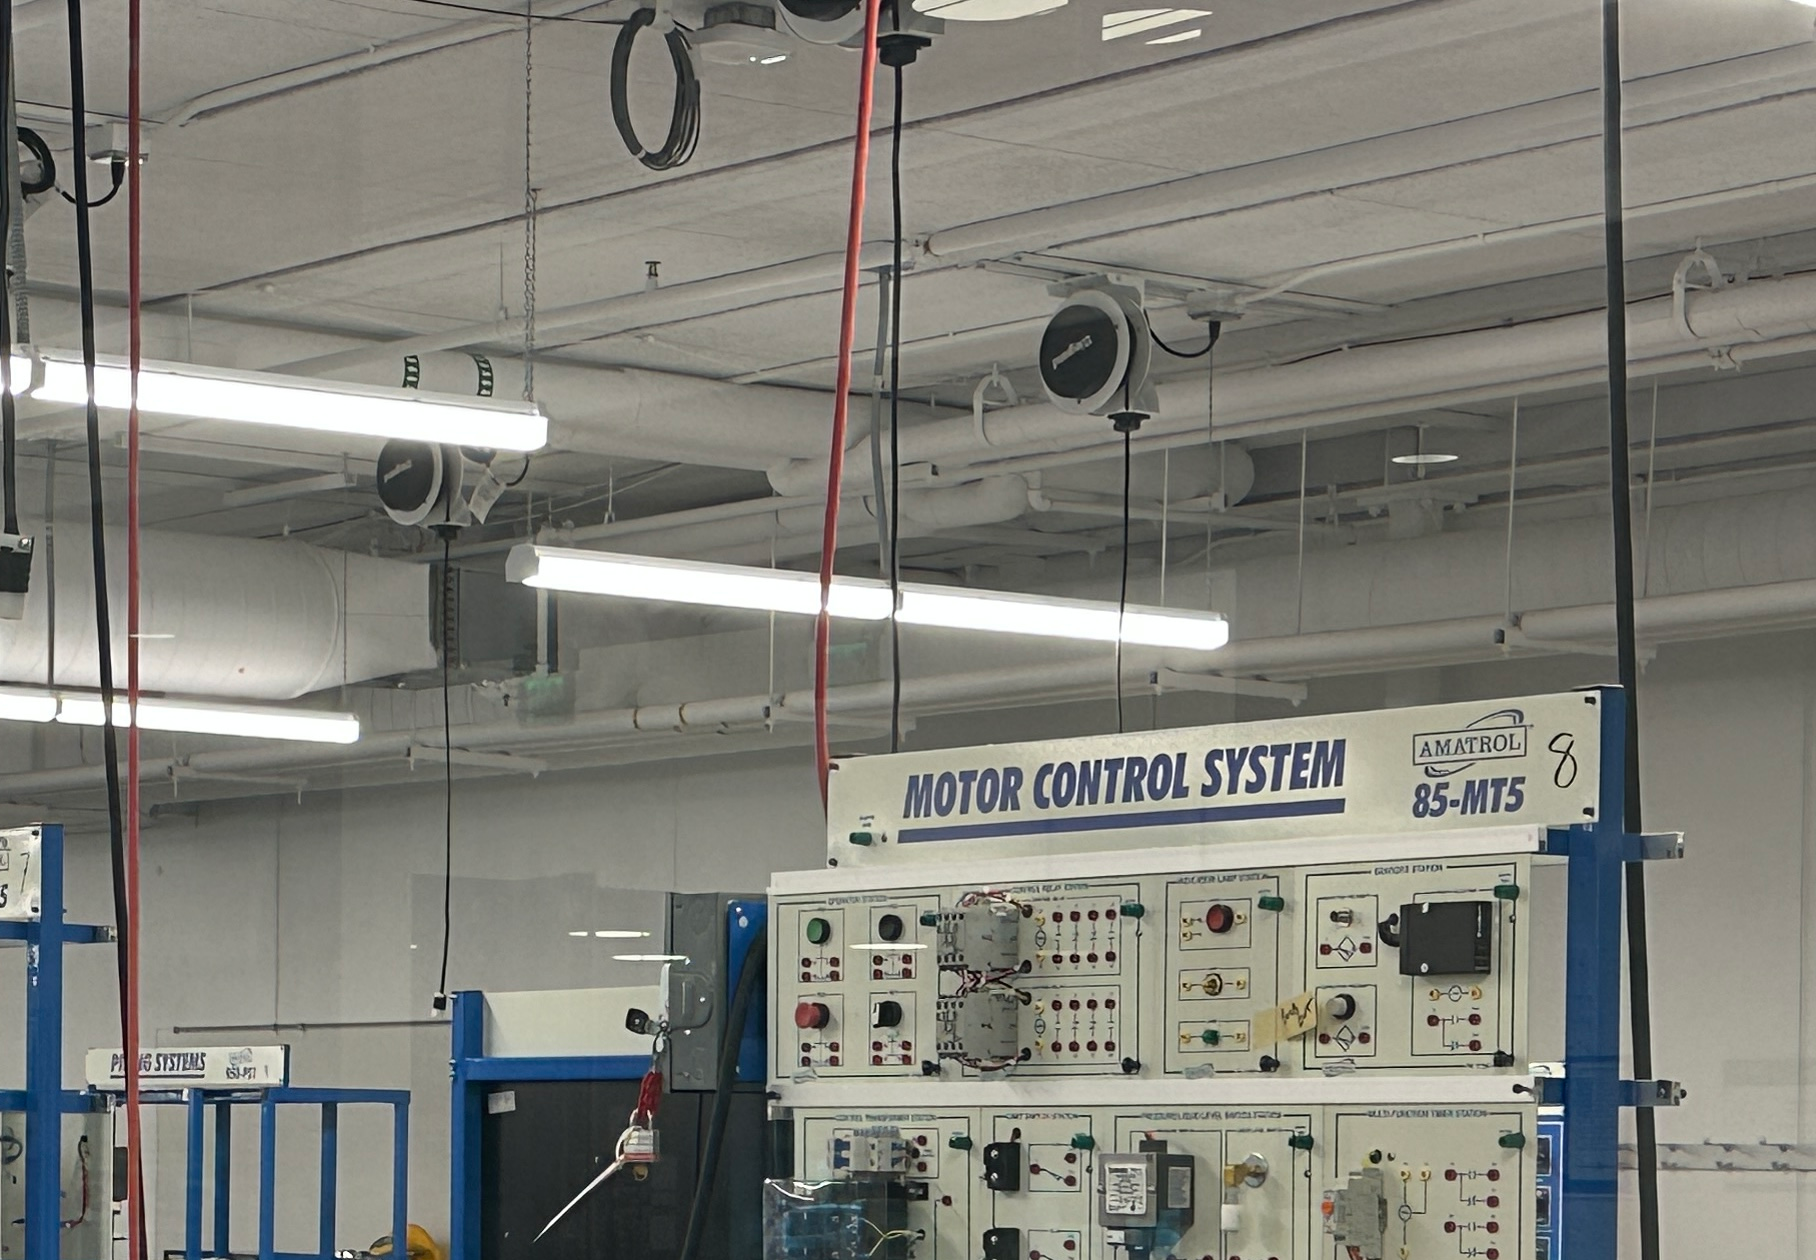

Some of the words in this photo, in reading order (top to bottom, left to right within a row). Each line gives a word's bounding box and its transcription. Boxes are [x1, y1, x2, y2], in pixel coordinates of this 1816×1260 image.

[1419, 733, 1521, 758] AMATROL
[1548, 733, 1577, 789] 8
[902, 766, 1024, 819] MOTOR
[1033, 752, 1189, 810] CONTROL
[1200, 738, 1347, 798] SYSTEM
[1412, 776, 1526, 819] 85-MT5
